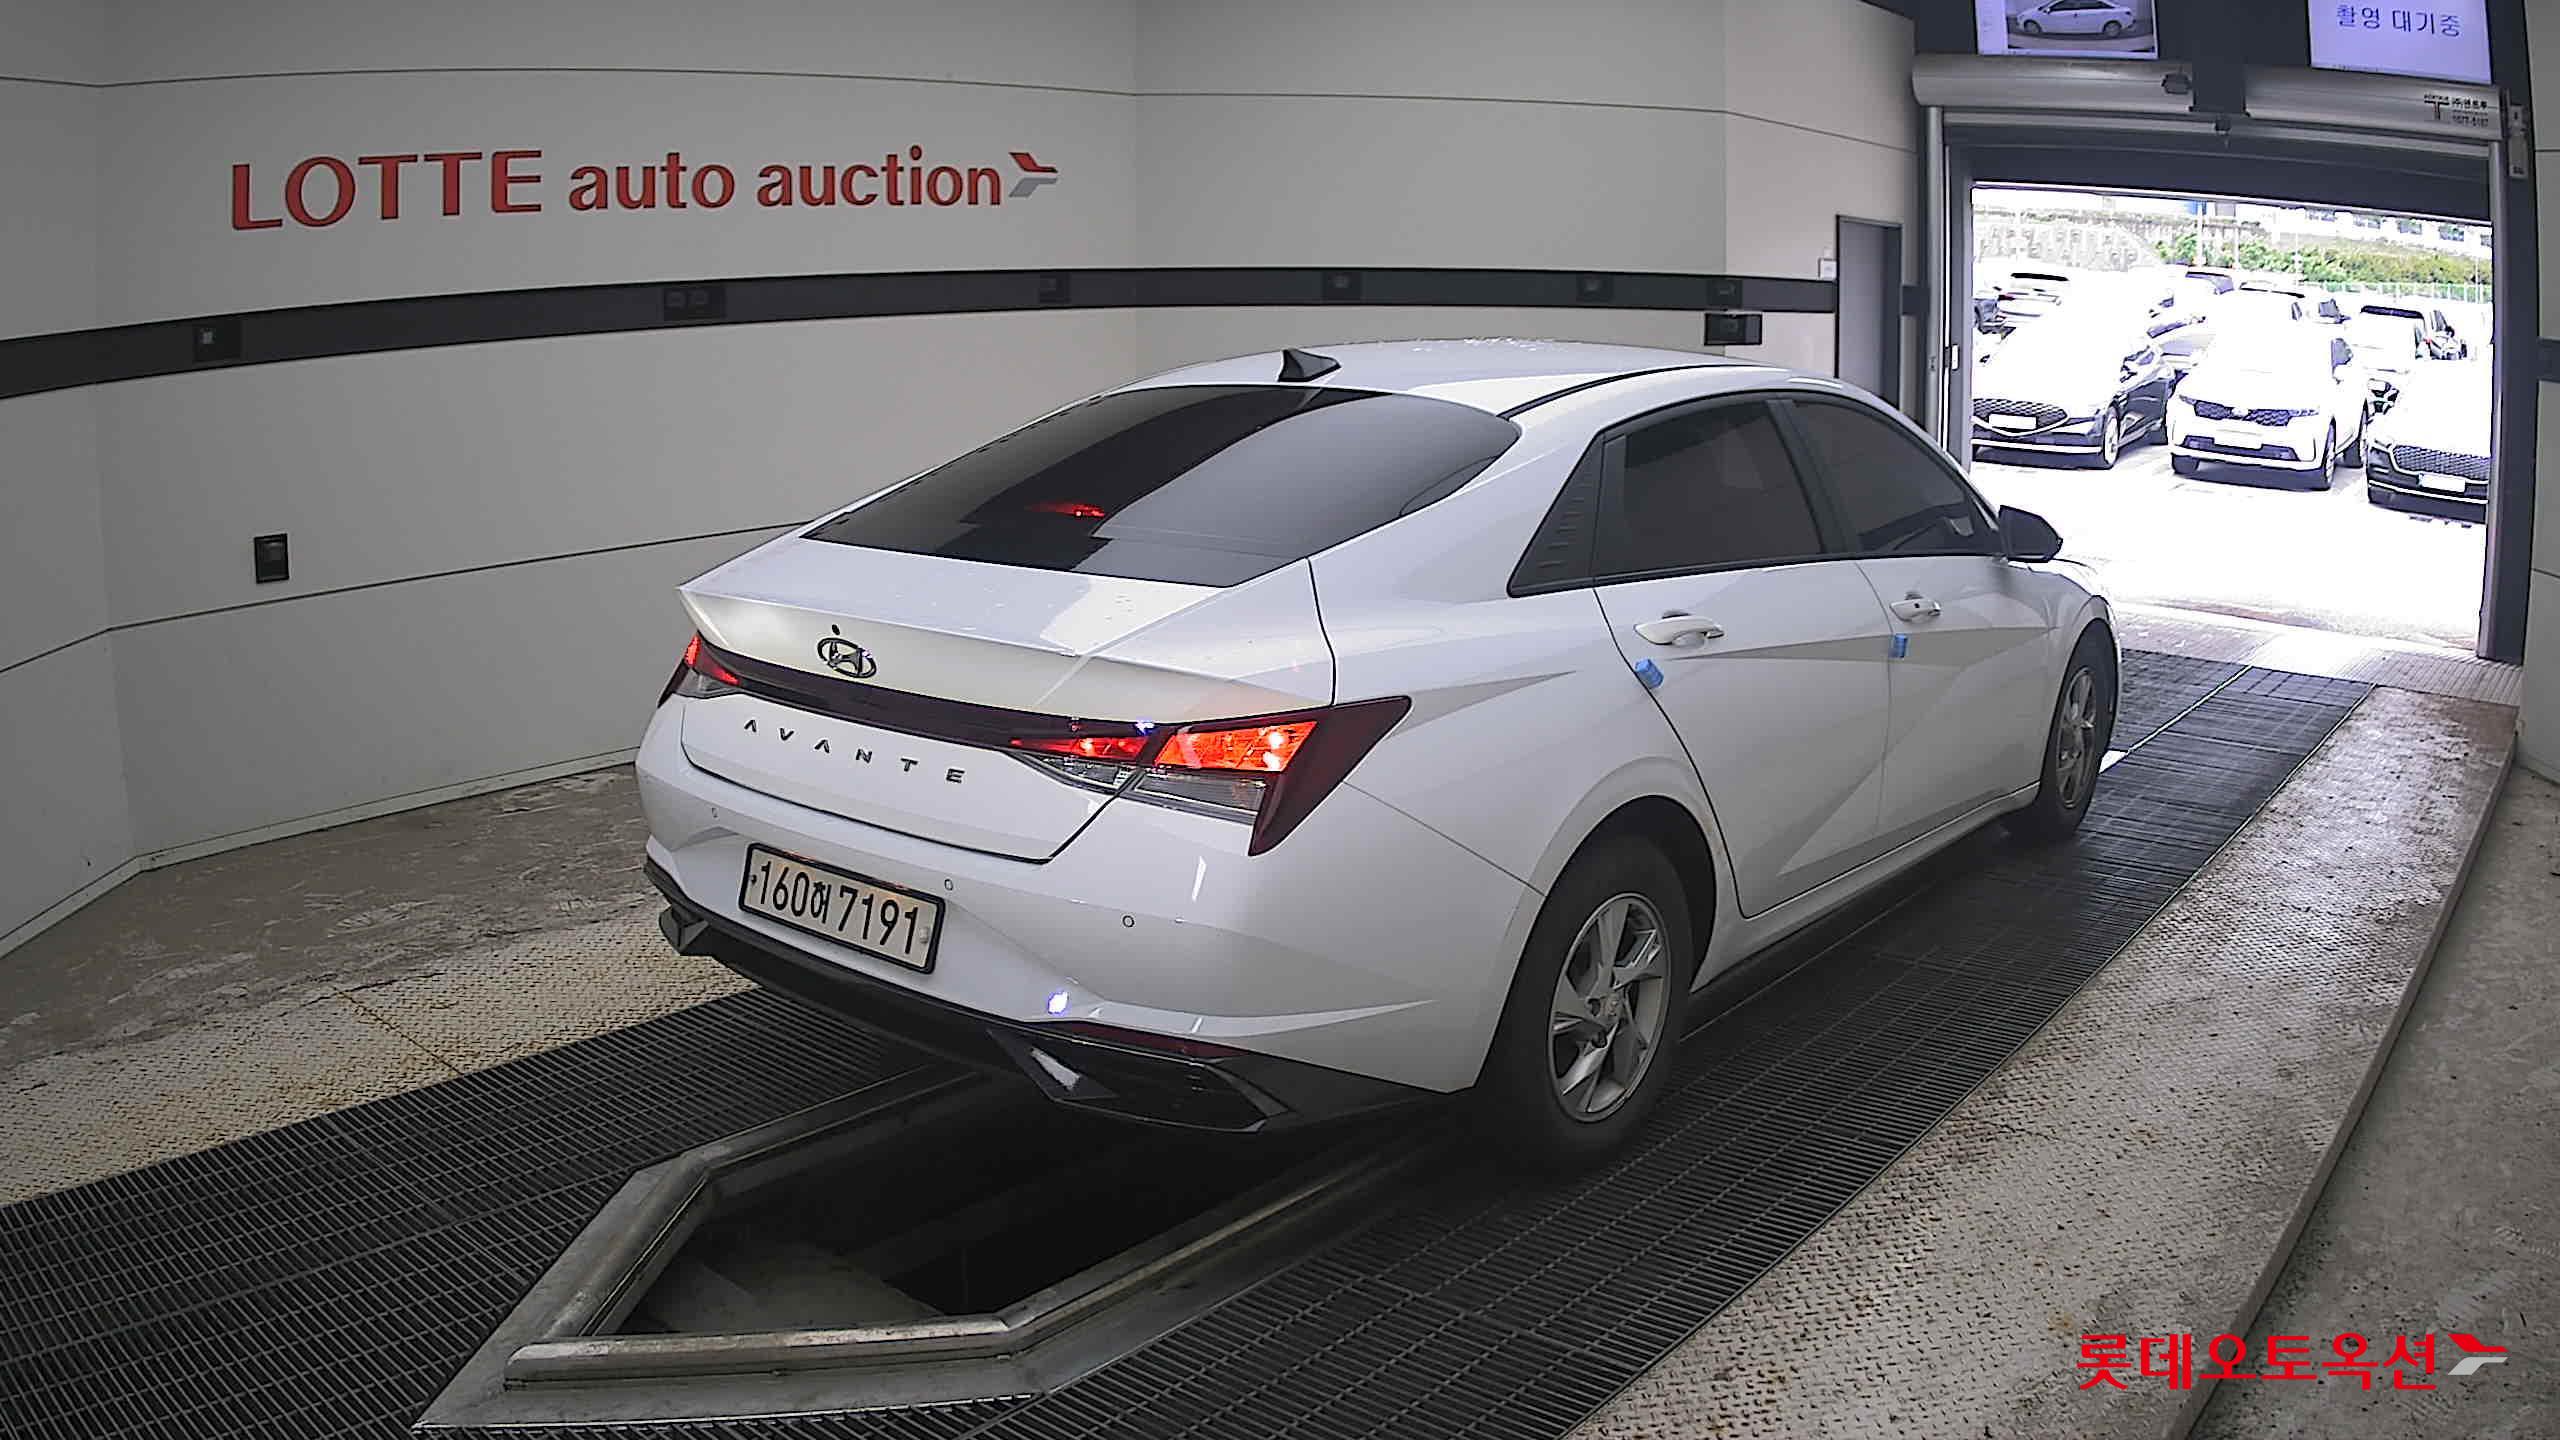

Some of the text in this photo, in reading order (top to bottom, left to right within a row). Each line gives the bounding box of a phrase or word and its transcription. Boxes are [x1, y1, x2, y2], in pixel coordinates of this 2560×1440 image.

[2337, 4, 2462, 37] 촬영 대기중
[232, 146, 1002, 230] LOTTE auto auction
[744, 718, 966, 784] AVANTE
